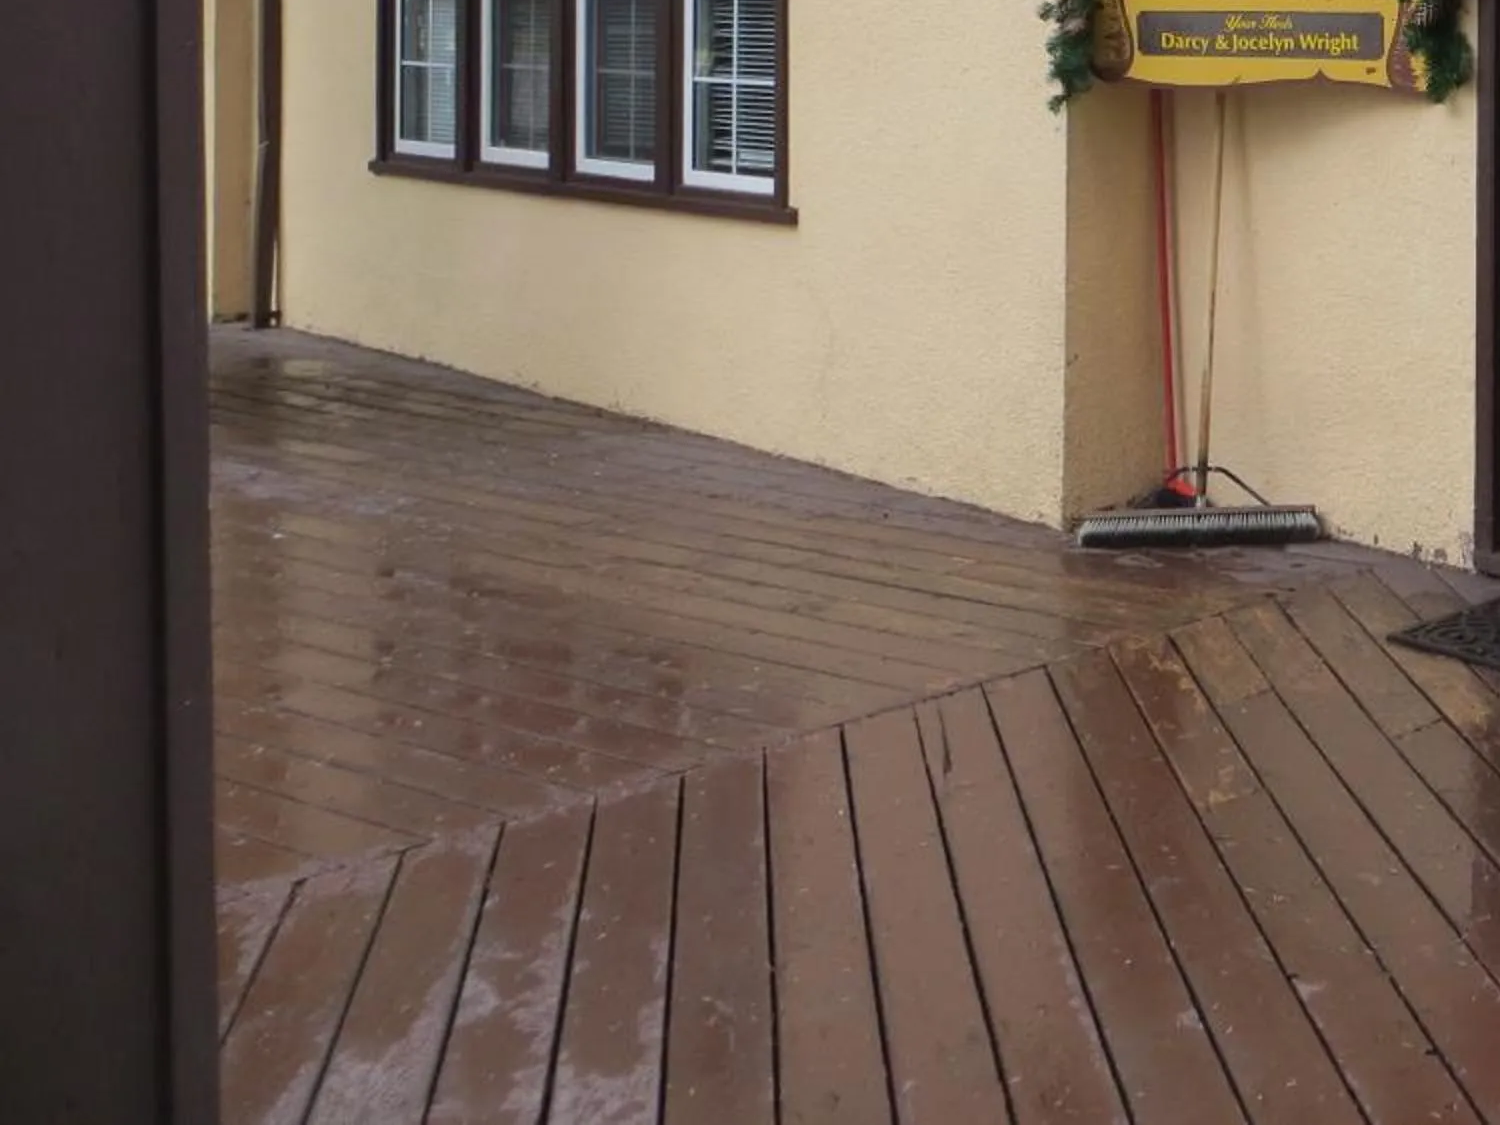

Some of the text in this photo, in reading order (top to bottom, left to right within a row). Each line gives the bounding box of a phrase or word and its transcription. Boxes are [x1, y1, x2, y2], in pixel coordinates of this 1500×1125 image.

[1160, 32, 1360, 56] Darcy & Jocelyn Wright
